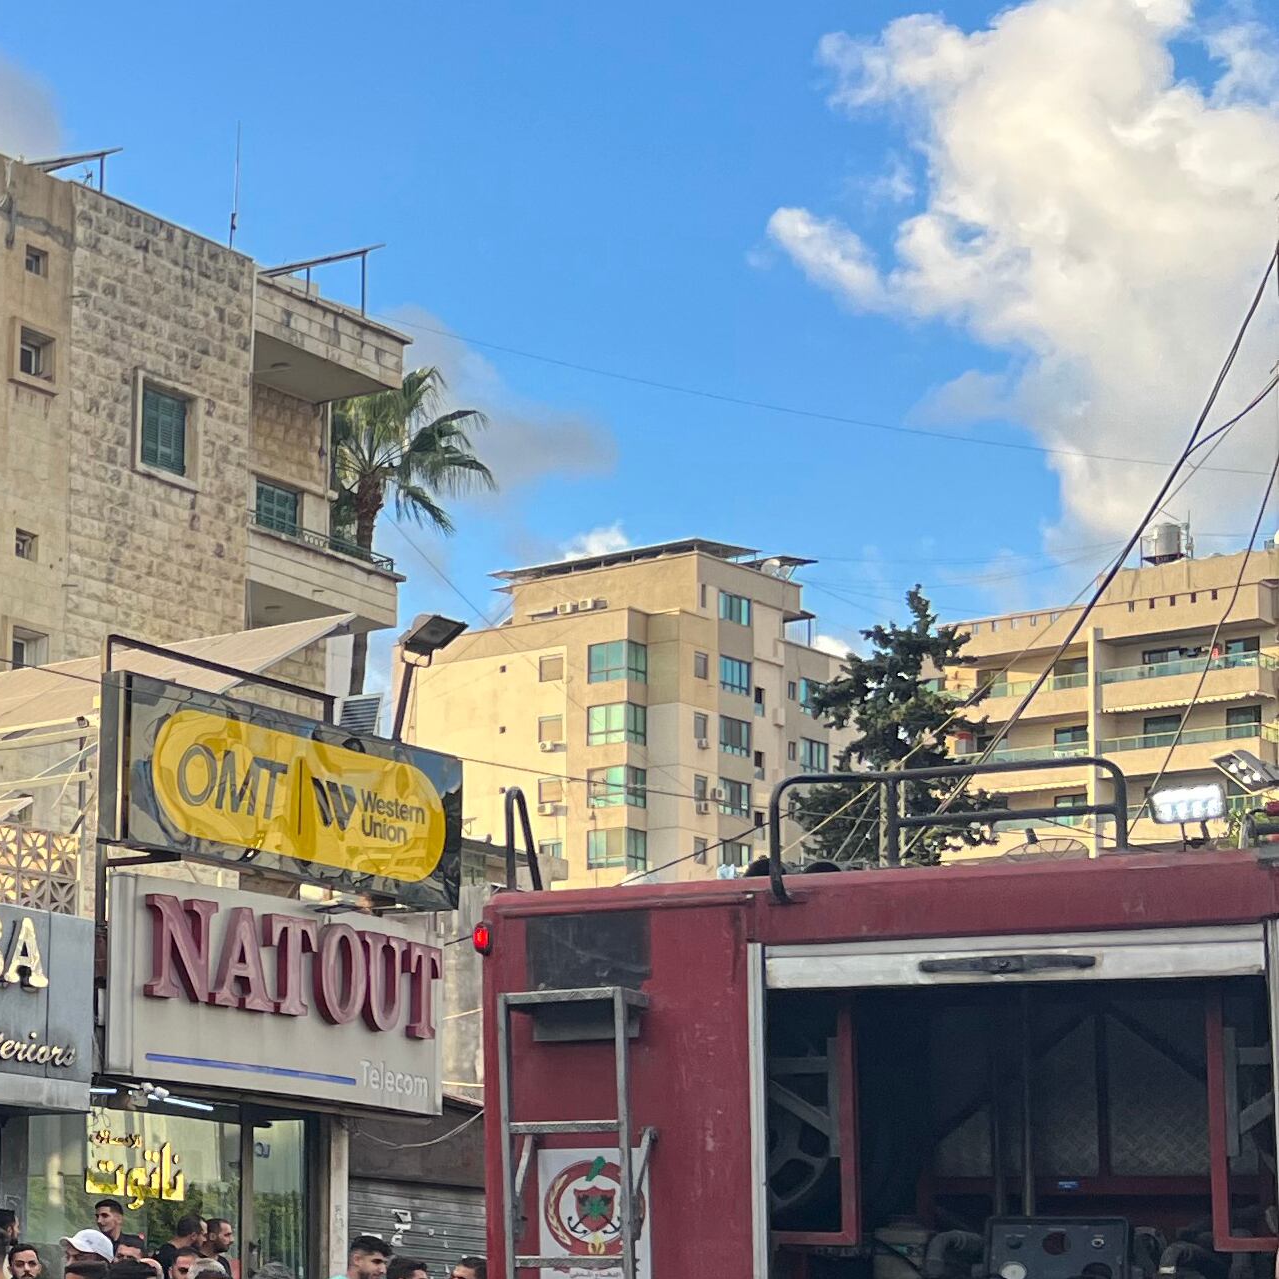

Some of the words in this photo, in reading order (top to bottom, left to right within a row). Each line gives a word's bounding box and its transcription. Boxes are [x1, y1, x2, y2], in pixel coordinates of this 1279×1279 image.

[177, 742, 289, 822] OMT
[360, 787, 426, 827] Western
[360, 813, 408, 847] Union
[143, 892, 441, 1040] NATOUT
[358, 1058, 430, 1100] Telecom
[85, 1141, 185, 1210] ناتوت
